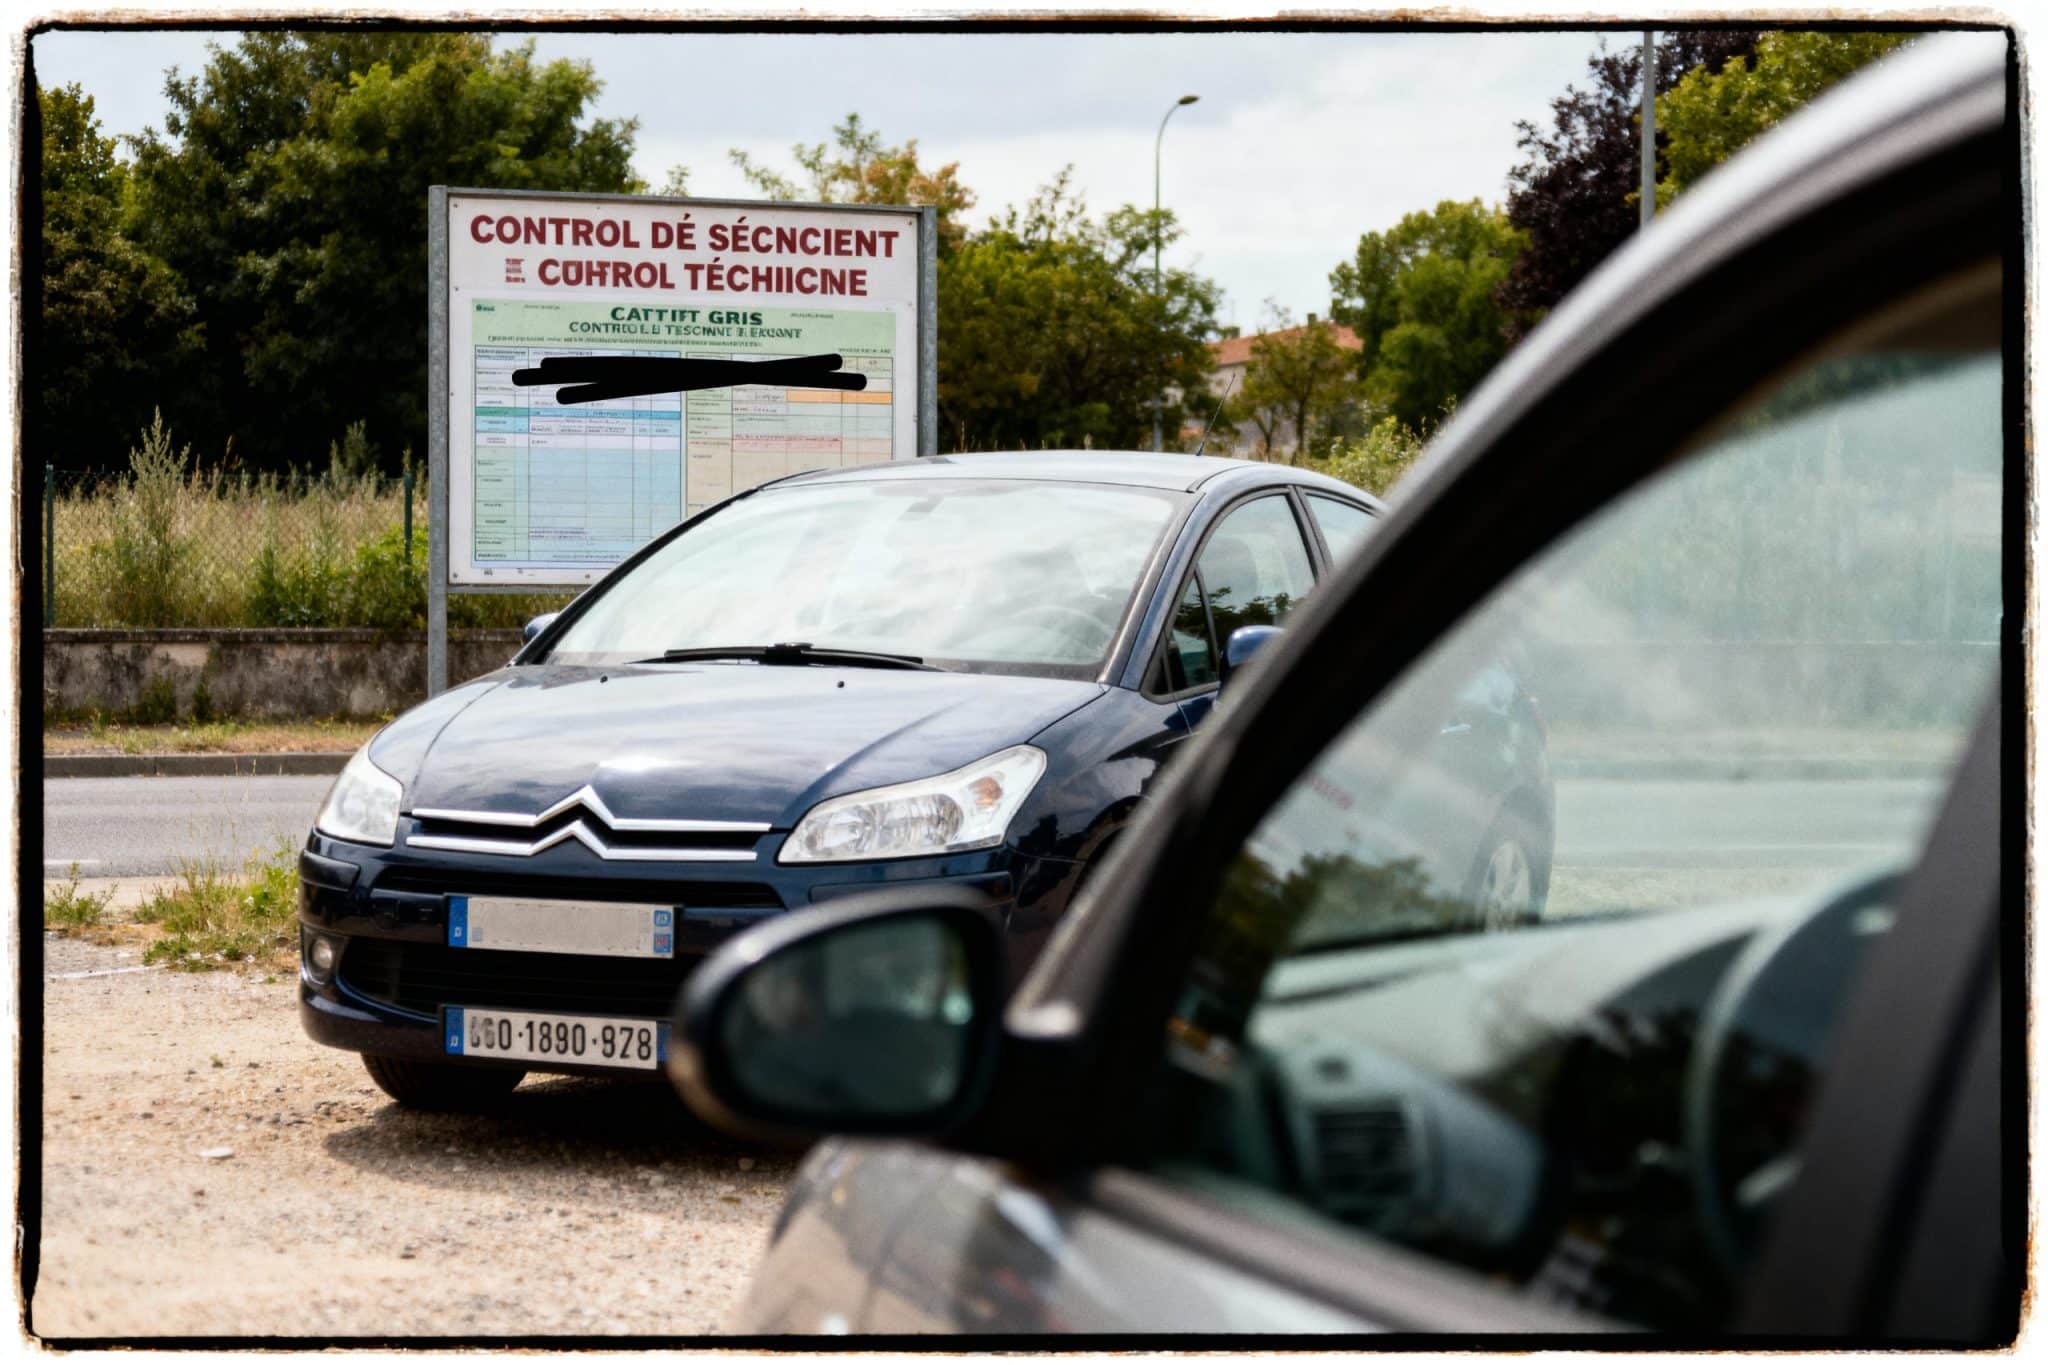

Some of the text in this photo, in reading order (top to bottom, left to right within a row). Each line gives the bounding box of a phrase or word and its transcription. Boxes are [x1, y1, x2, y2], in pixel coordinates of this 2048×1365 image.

[470, 213, 899, 258] CONTROL DÉ SÉCNCIENT
[708, 310, 763, 326] GRIS
